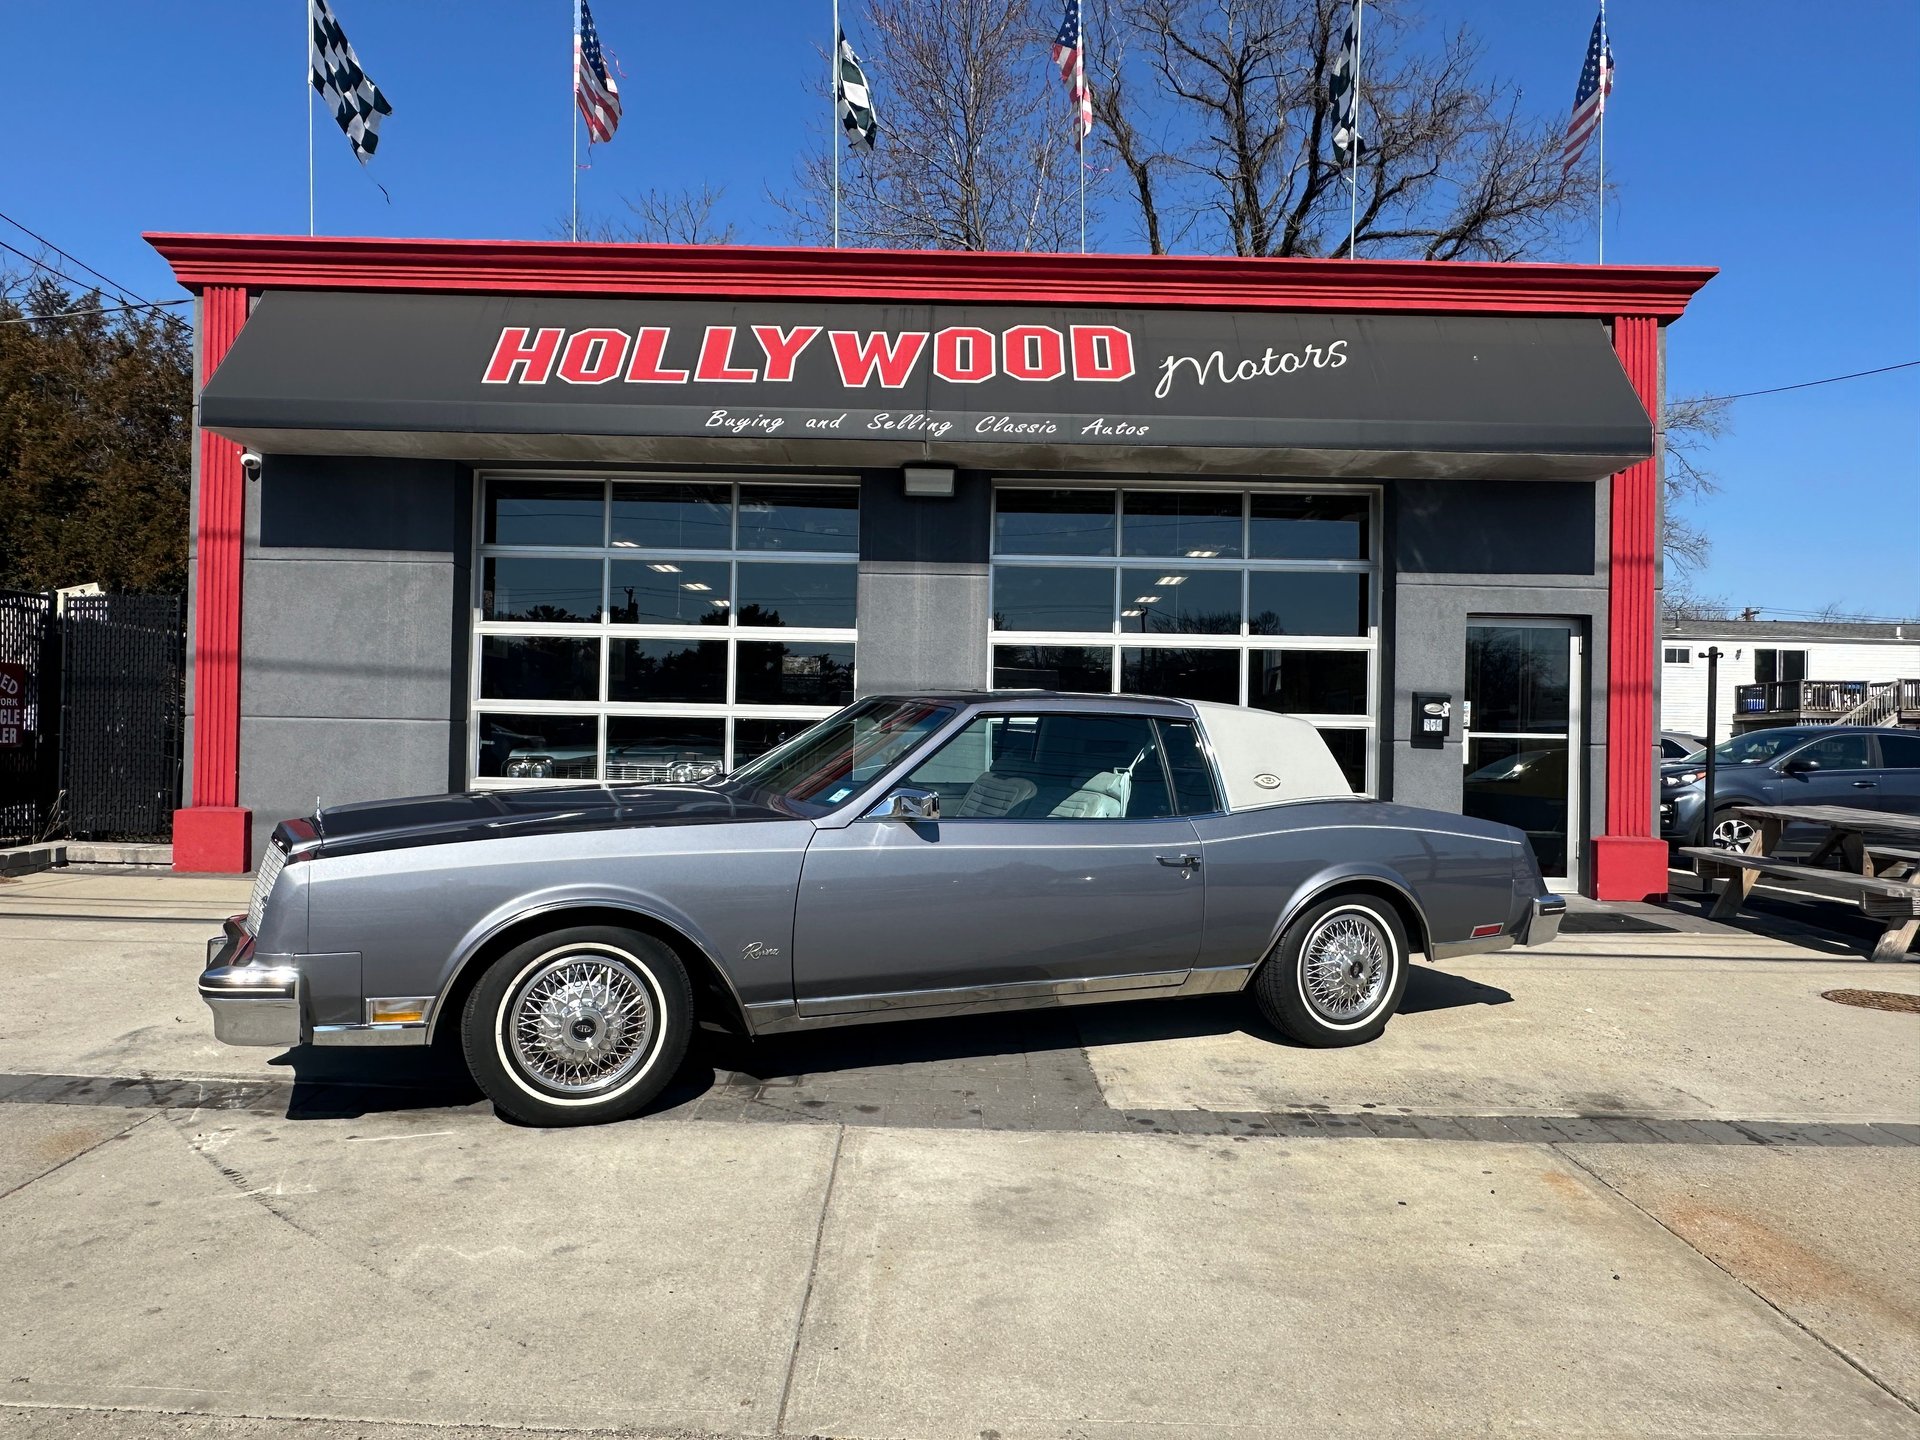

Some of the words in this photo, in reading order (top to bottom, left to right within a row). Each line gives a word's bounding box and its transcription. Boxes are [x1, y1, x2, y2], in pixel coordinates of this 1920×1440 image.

[481, 325, 1136, 390] HOLLYWOOD
[1155, 340, 1348, 399] Motors
[705, 409, 785, 433] Buying
[805, 413, 847, 430] and
[866, 412, 953, 437] Selling
[974, 415, 1057, 433] Classic
[1080, 417, 1150, 436] Autos
[0, 673, 18, 695] ED
[0, 727, 17, 744] ER
